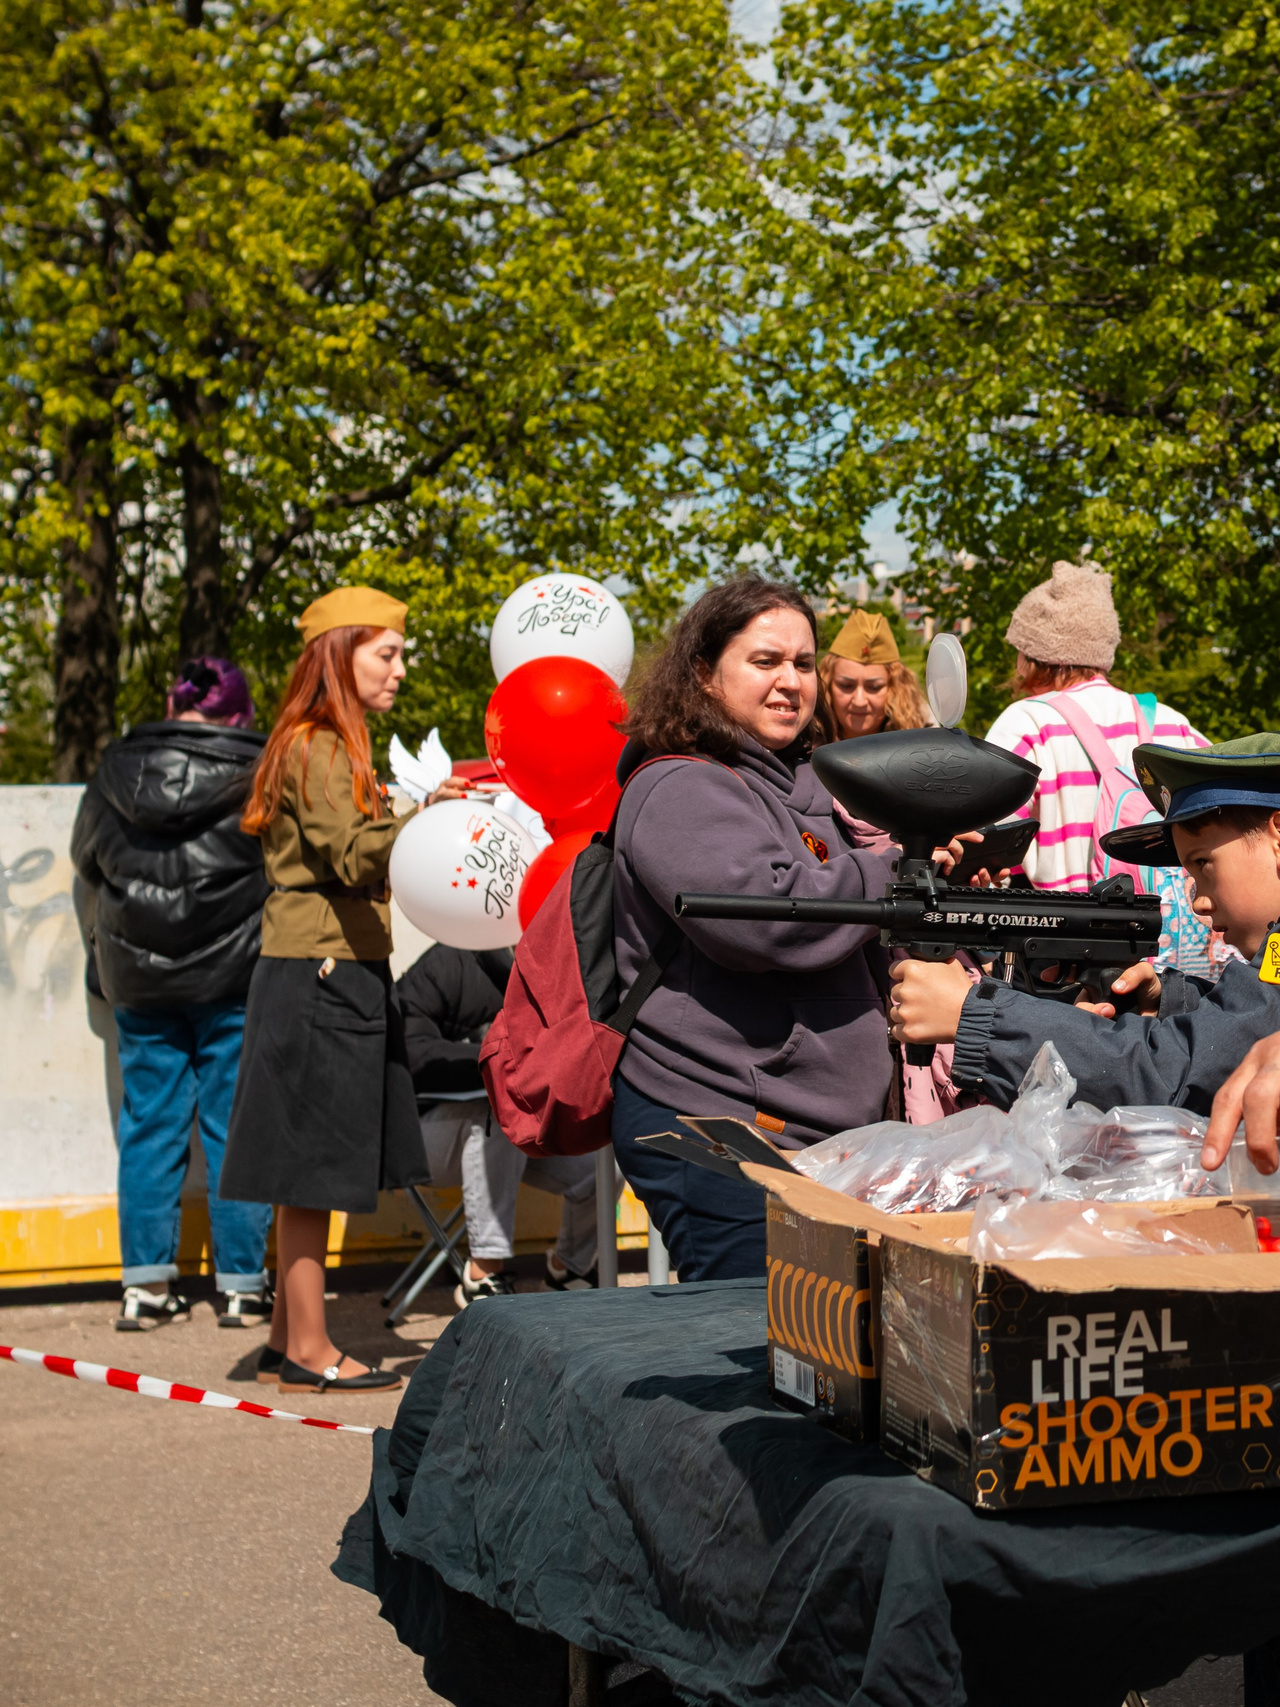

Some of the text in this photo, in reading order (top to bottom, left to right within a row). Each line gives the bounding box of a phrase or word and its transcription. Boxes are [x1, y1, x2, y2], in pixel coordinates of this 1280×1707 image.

[946, 912, 1061, 928] BT-4 COMBAT
[1047, 1308, 1188, 1360] REAL
[1032, 1352, 1144, 1404] LIFE
[1000, 1384, 1274, 1448] SHOOTER
[1014, 1431, 1203, 1491] AMMO
